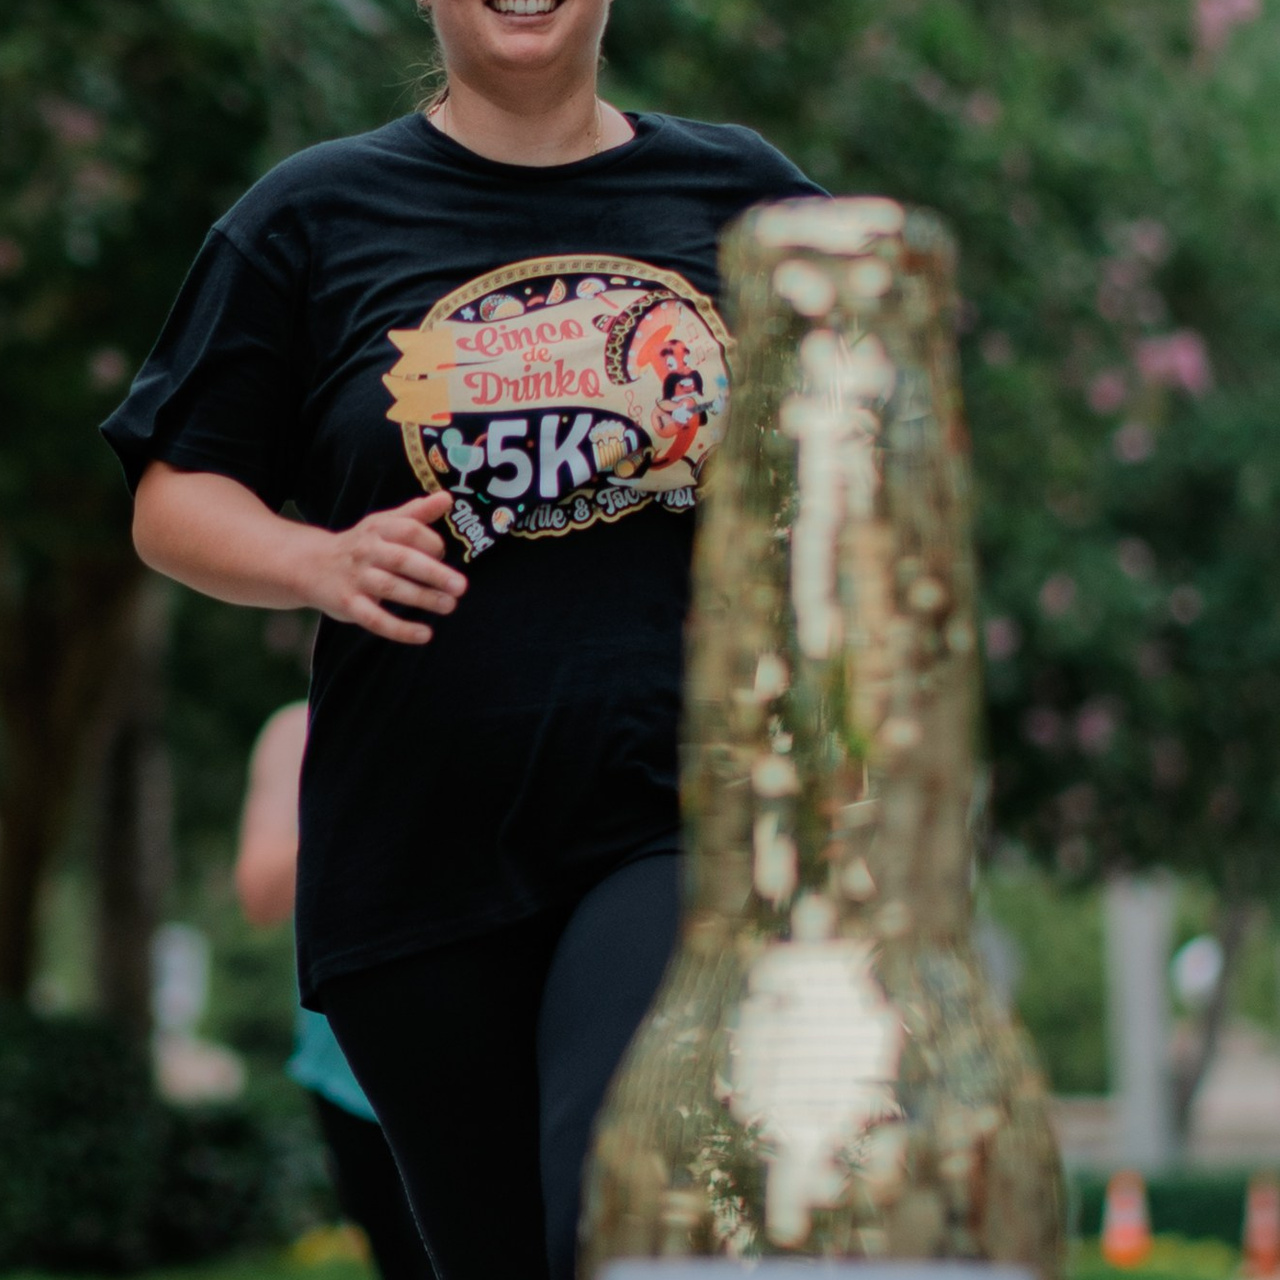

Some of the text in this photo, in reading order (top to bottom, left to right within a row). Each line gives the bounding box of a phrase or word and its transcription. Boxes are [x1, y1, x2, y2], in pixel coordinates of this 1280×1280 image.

[456, 319, 587, 357] Cinco
[522, 347, 552, 362] de
[463, 359, 605, 405] Drinko
[486, 414, 594, 499] 5K
[573, 498, 592, 521] &
